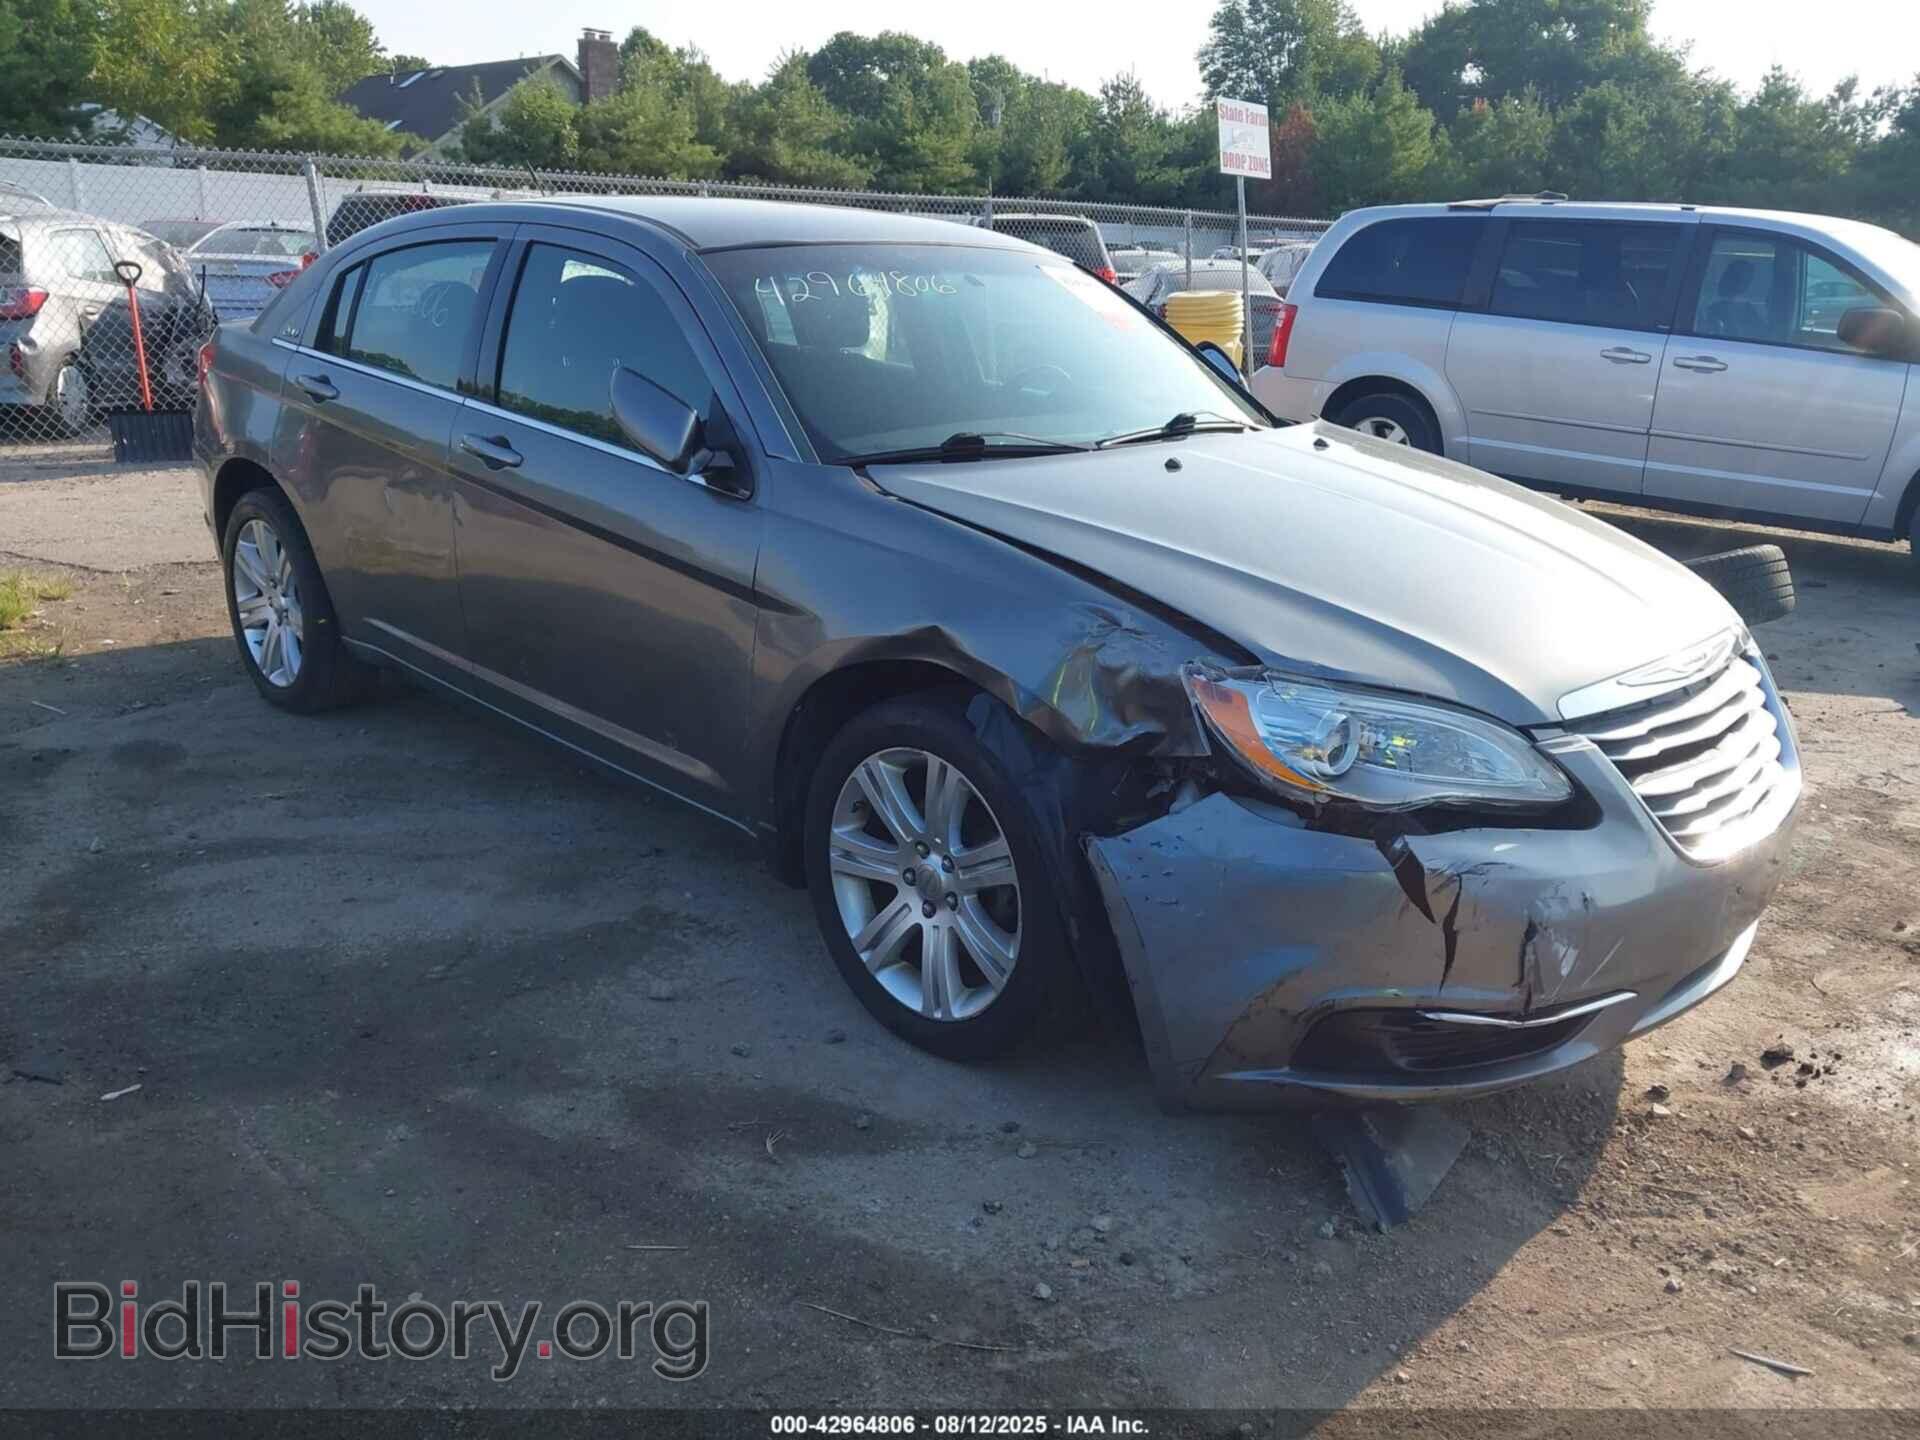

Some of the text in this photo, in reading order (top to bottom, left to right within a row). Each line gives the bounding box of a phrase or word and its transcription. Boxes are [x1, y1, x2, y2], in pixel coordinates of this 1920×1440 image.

[1219, 103, 1268, 127] State Farm
[1223, 151, 1270, 174] DROP ZONE
[754, 271, 958, 306] 42964806
